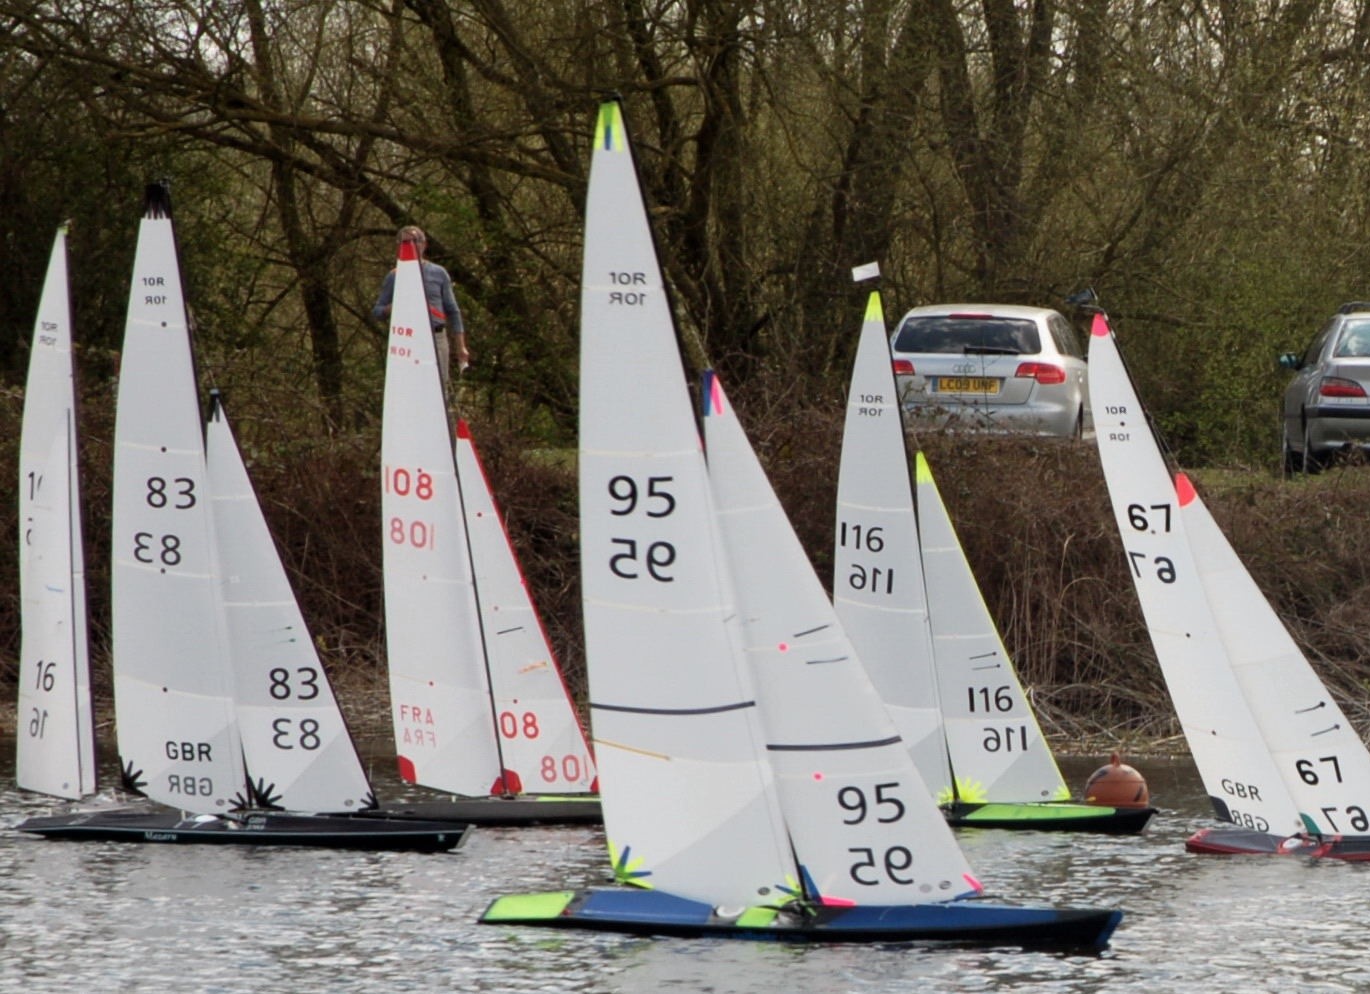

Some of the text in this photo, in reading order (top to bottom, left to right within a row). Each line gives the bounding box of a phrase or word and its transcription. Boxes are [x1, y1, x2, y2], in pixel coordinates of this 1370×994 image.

[142, 277, 164, 286] 10R
[609, 272, 646, 285] 10R
[391, 327, 413, 336] 10R
[860, 394, 883, 403] 10R
[146, 477, 196, 509] 83
[385, 468, 432, 500] 108
[607, 476, 675, 518] 95
[1127, 503, 1172, 534] 67
[840, 522, 883, 552] 116
[36, 661, 56, 692] 16
[269, 667, 319, 700] 83
[967, 686, 1013, 712] 116
[399, 705, 433, 724] FRA
[500, 711, 540, 740] 08
[165, 741, 212, 762] GBR
[1295, 756, 1342, 785] 67
[837, 782, 905, 825] 95
[1221, 778, 1263, 802] GBR
